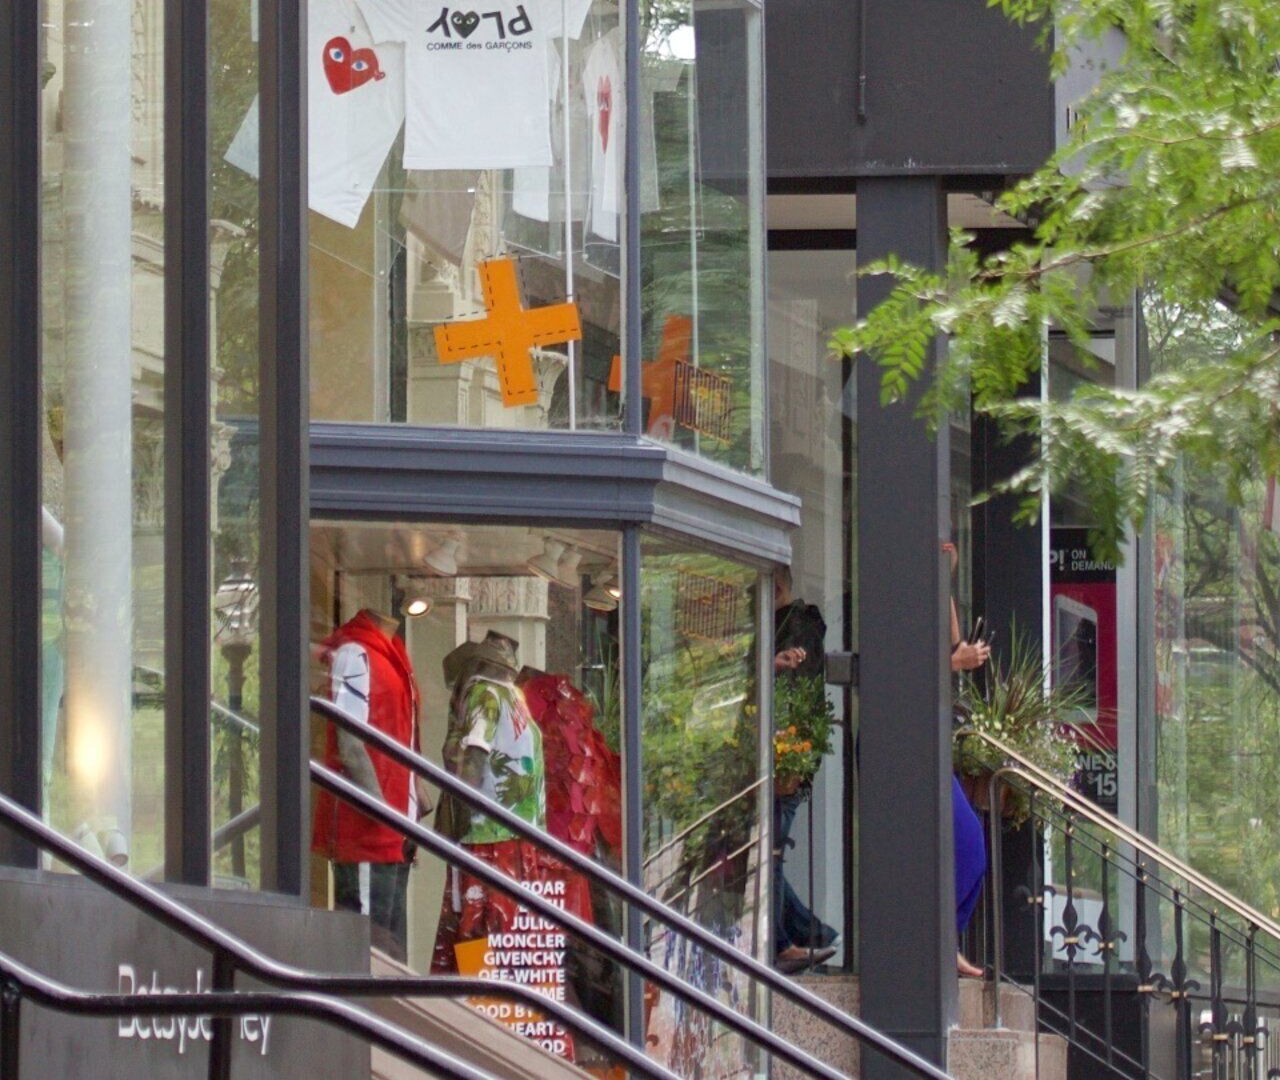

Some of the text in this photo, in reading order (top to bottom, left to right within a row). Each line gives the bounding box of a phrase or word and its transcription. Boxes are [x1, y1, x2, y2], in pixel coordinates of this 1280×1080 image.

[426, 40, 533, 54] COMME des GARÇONS
[487, 933, 565, 949] MONCLER
[483, 951, 565, 966] GIVENCHY
